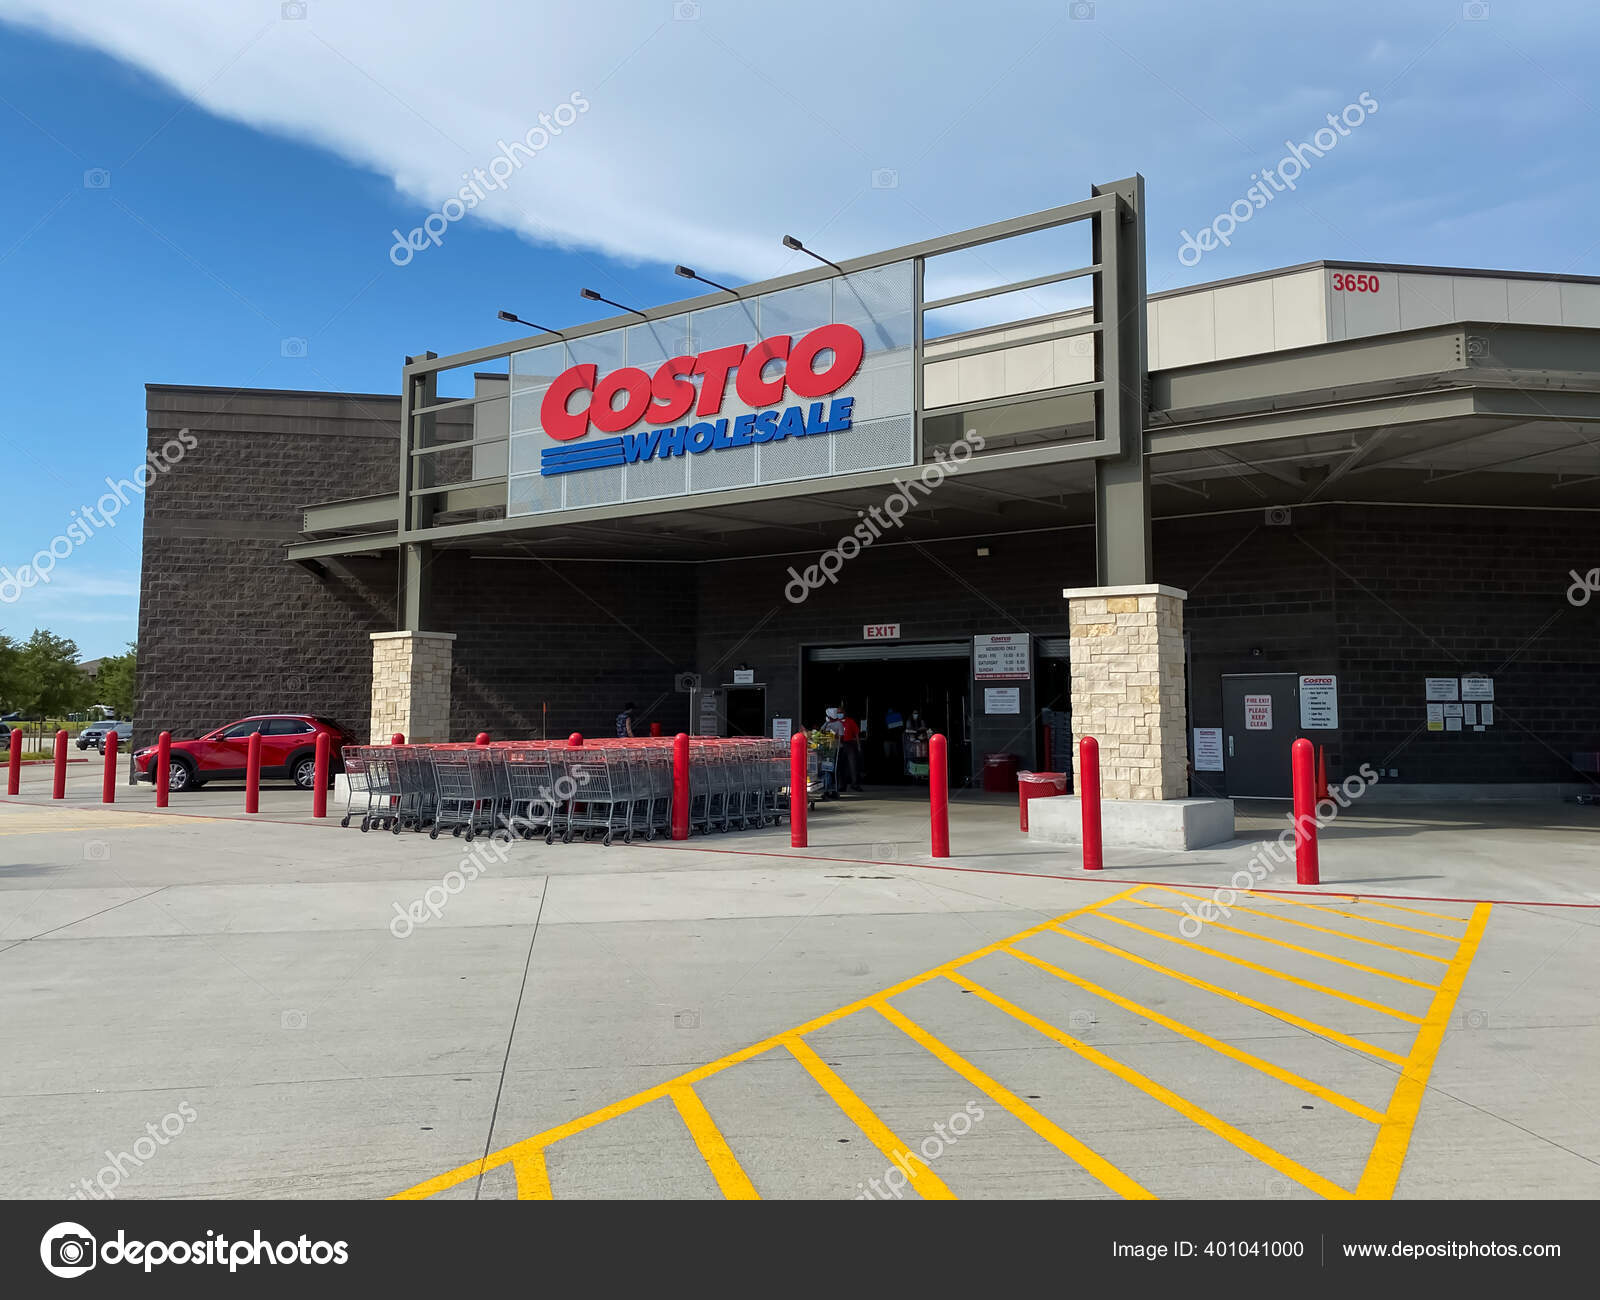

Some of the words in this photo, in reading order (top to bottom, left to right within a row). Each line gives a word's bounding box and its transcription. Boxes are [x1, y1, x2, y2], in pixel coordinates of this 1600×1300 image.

[1333, 273, 1380, 293] 3650
[541, 324, 865, 441] COSTCO
[622, 397, 855, 463] WHOLESALE
[867, 626, 896, 637] EXIT
